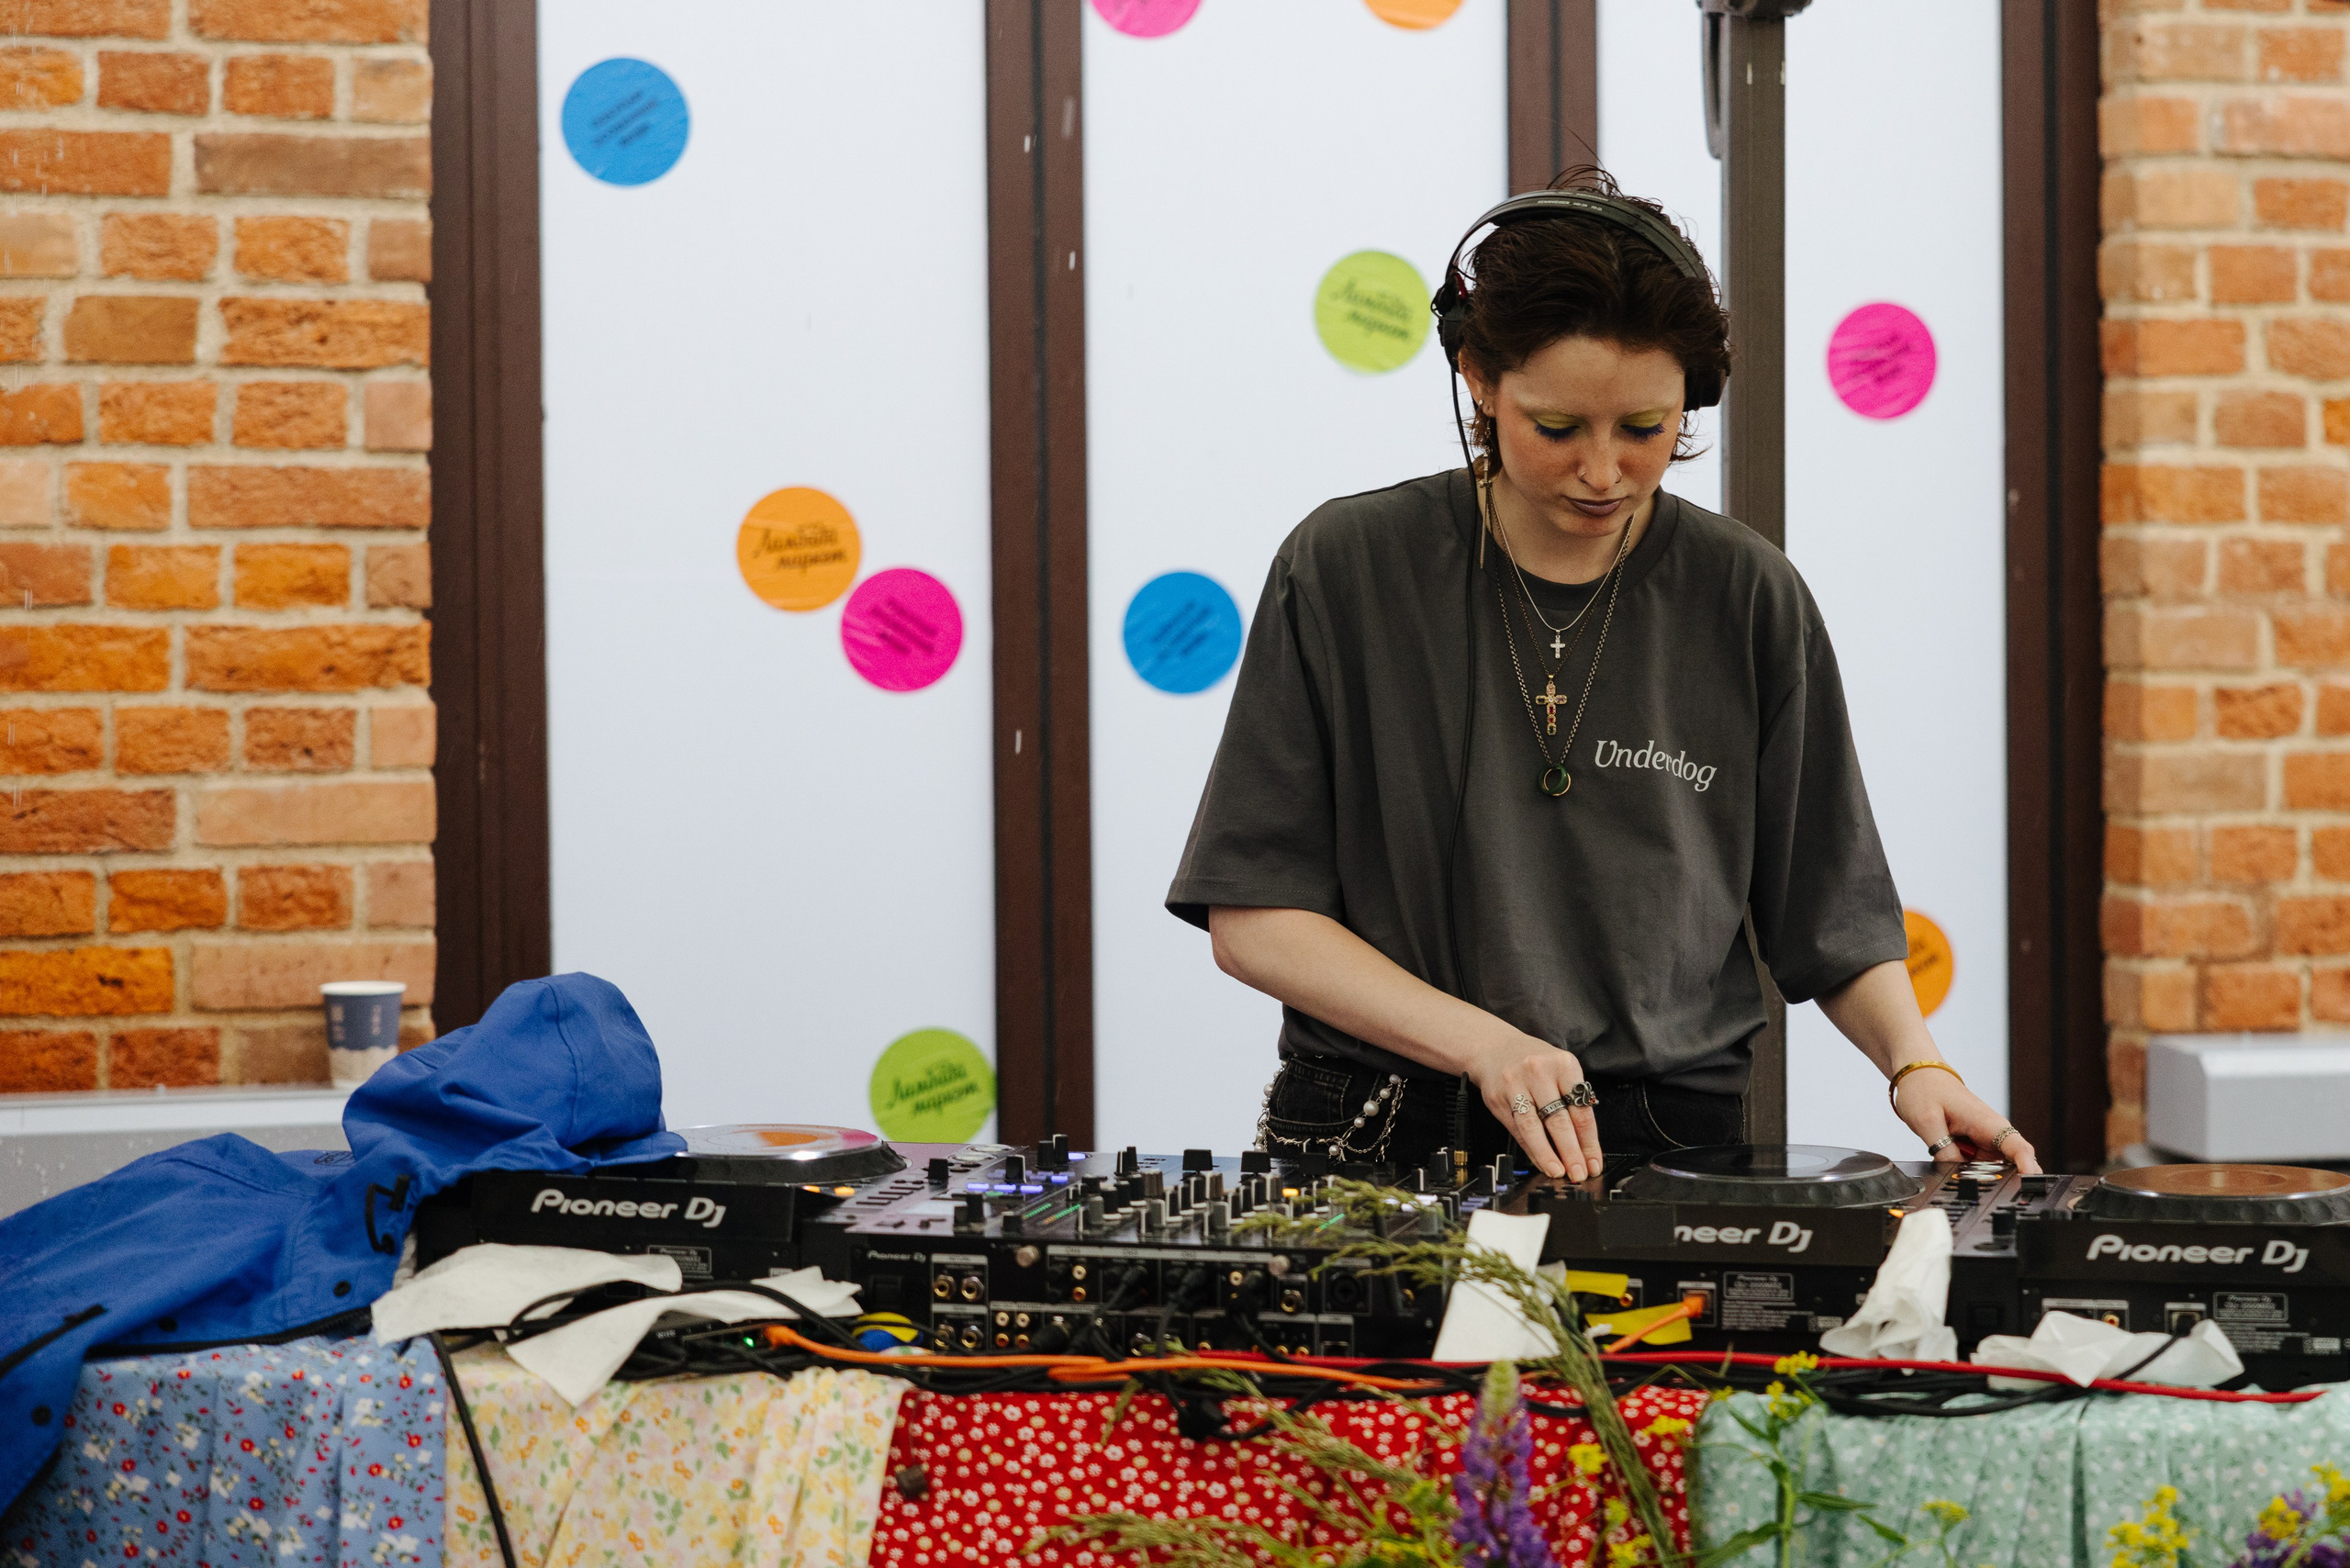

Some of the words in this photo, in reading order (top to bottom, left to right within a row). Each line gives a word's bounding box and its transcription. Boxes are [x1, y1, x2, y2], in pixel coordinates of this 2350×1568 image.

[1595, 740, 1718, 792] Underdog
[531, 1188, 678, 1219] Pioneer
[1673, 1225, 1762, 1245] neer
[2087, 1234, 2255, 1264] Pioneer
